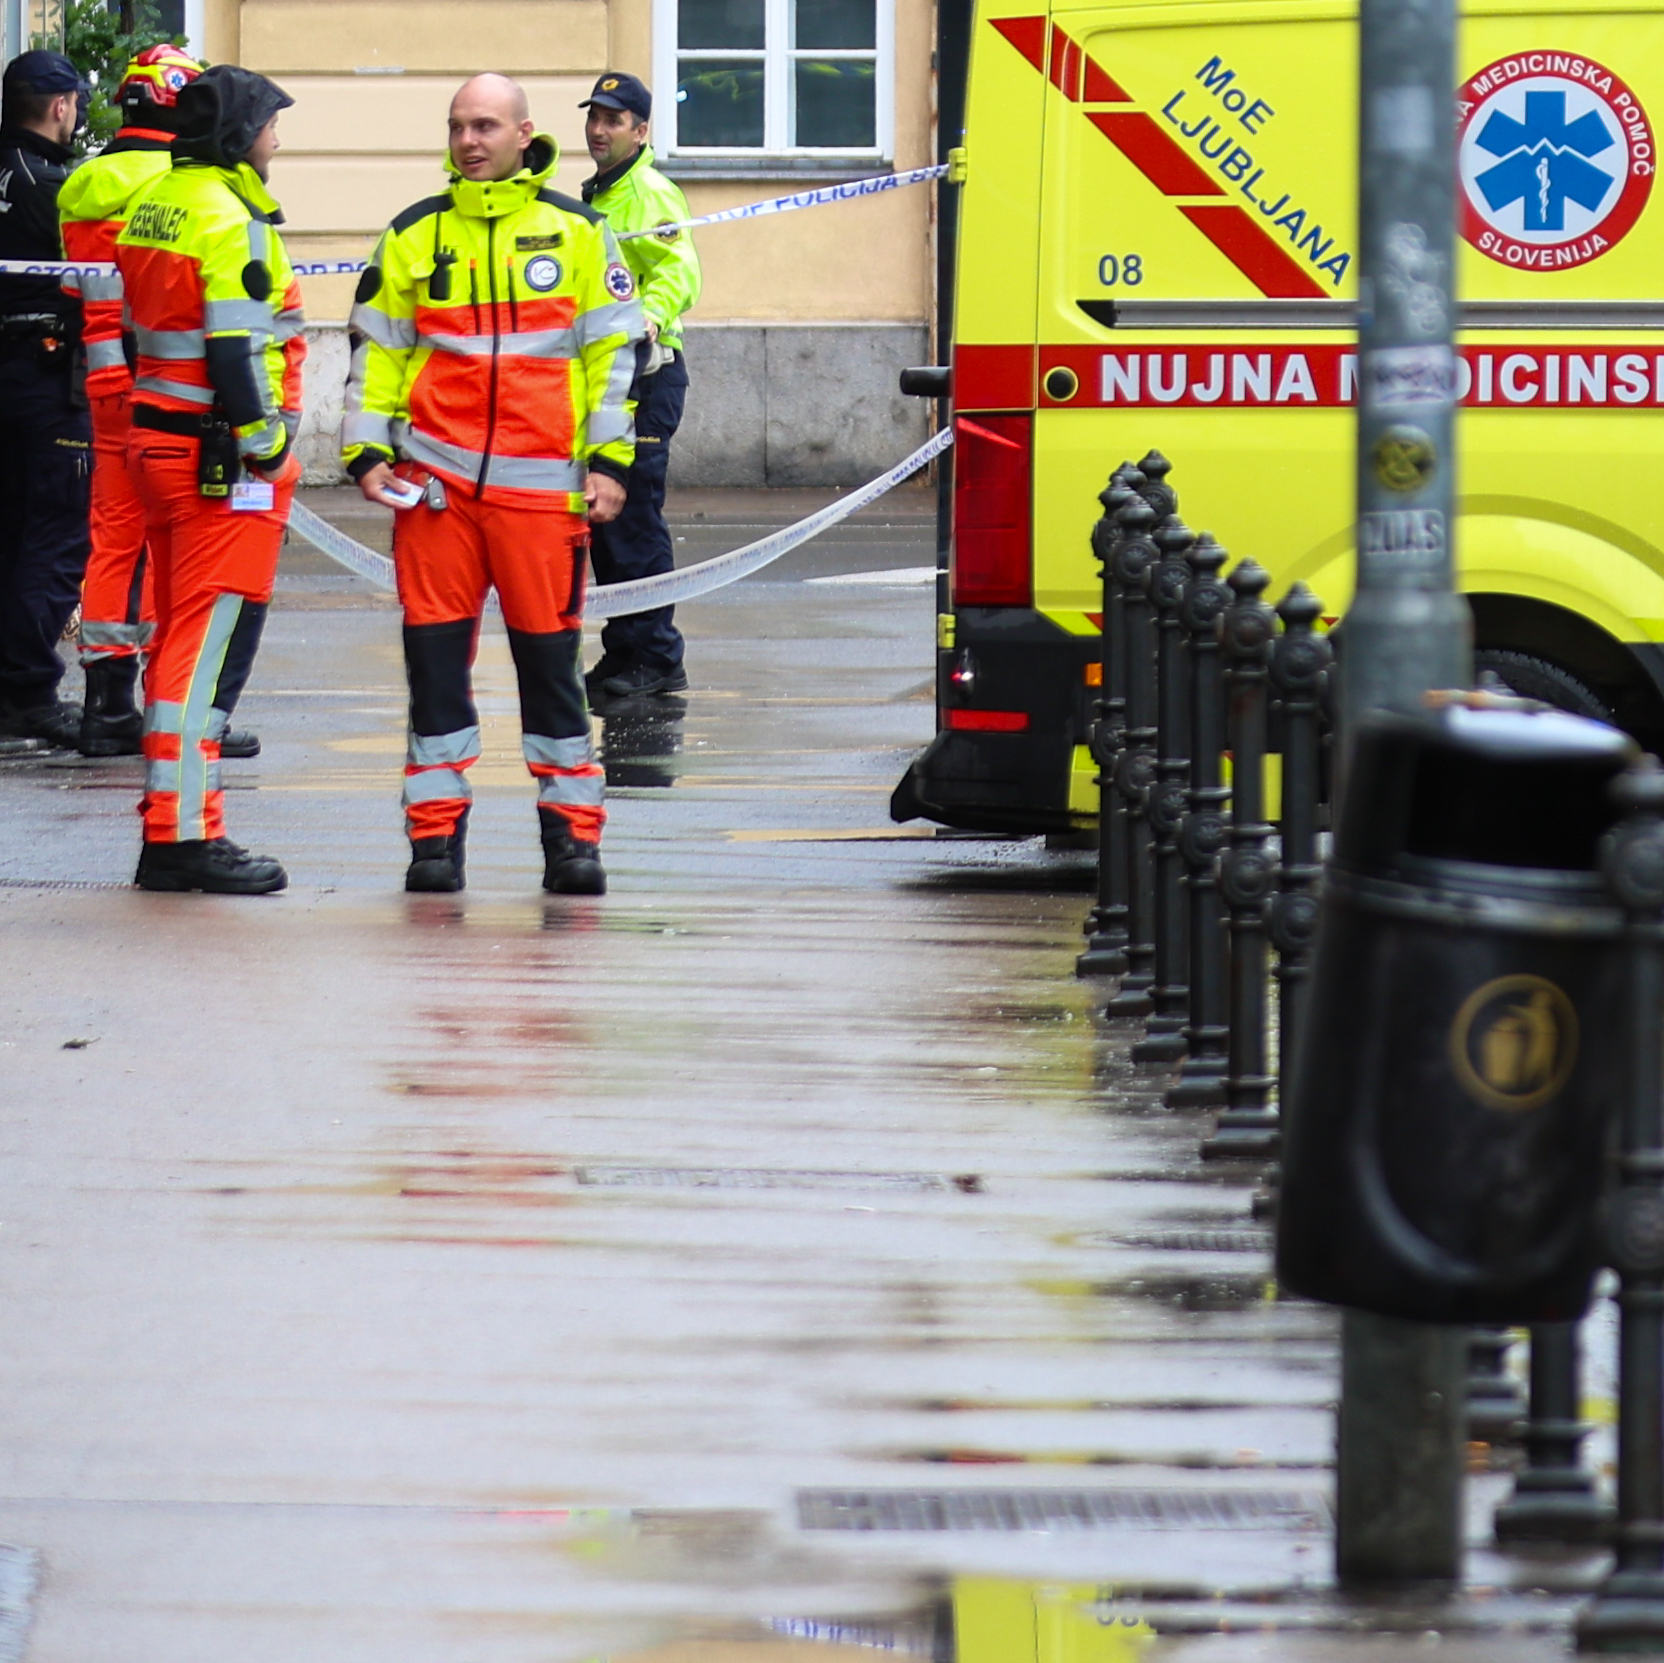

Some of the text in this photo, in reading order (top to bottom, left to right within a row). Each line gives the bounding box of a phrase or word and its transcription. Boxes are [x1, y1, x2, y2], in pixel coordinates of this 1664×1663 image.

[1195, 55, 1275, 135] MoE
[1472, 55, 1656, 177] MEDICINSKA POMOČ
[1161, 89, 1352, 286] LJUBLJANA
[1099, 253, 1144, 286] 08
[1479, 231, 1608, 267] SLOVENIJA
[1101, 353, 1319, 402] NUJNA
